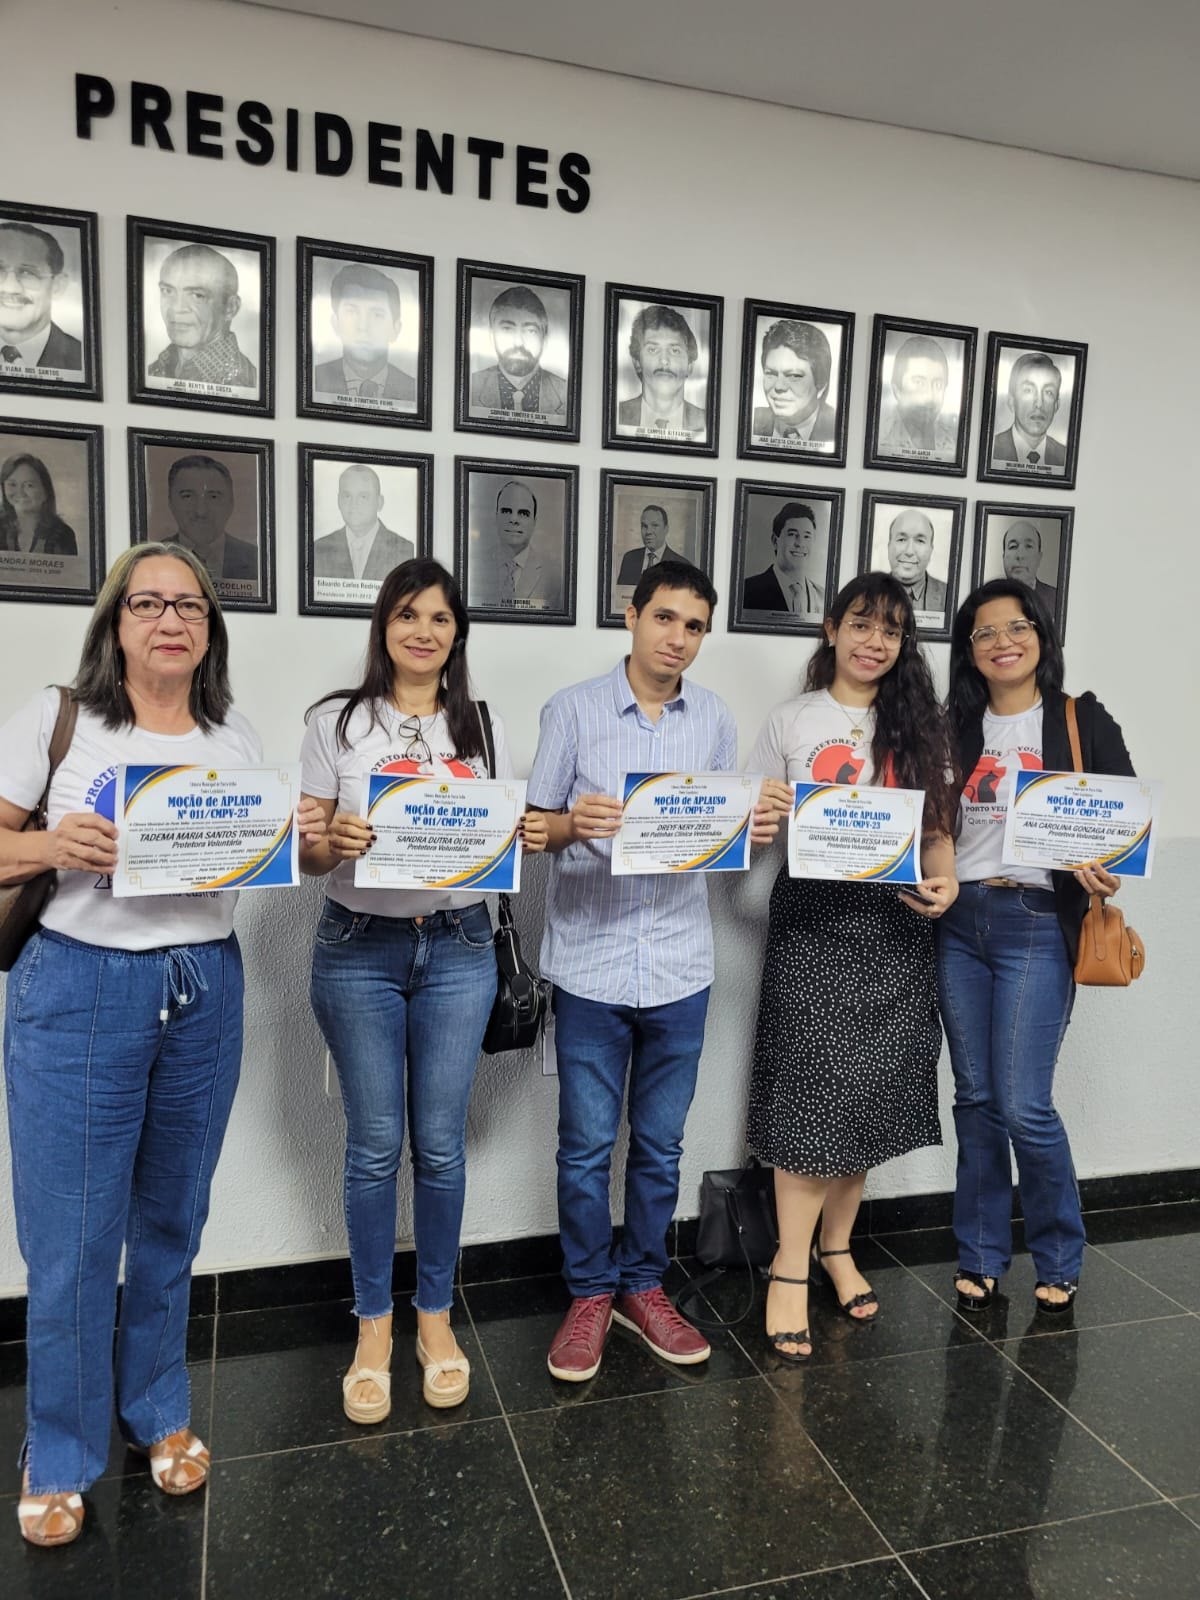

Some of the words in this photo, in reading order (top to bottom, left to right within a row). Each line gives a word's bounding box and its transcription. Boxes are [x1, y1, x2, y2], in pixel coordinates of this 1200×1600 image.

[75, 73, 592, 214] PRESIDENTES
[0, 557, 26, 566] ANDRA
[28, 560, 65, 568] MORAES
[220, 582, 252, 590] COELHO
[805, 738, 858, 768] PROTETORES
[371, 752, 422, 773] OTETORES
[85, 766, 118, 806] PROTE
[168, 794, 203, 808] MOÇÃO
[206, 796, 218, 807] de
[221, 794, 262, 807] APLAUSO
[654, 794, 679, 806] MOÇÃO
[682, 796, 692, 805] de
[694, 795, 726, 805] APLAUSO
[1046, 794, 1074, 807] MOÇÃO
[1076, 798, 1086, 806] de
[1088, 798, 1124, 811] APLAUSO
[189, 808, 249, 820] 011/CMPV-23
[404, 804, 434, 817] MOÇÃO
[438, 806, 448, 816] de
[450, 806, 488, 818] APLAUSO
[669, 806, 715, 815] 011/CMPV-23
[823, 807, 847, 819] MOÇÃO
[849, 809, 859, 819] de
[860, 811, 891, 821] APLAUSO
[1062, 807, 1112, 819] 011/CMPV-23
[423, 817, 476, 828] 011/CMPV-23
[838, 819, 881, 829] 011/CMPV-23
[1038, 822, 1072, 831] CAROLINA
[1073, 825, 1106, 834] GONZAGA
[1106, 827, 1115, 835] DE
[1116, 828, 1137, 837] MELO
[140, 832, 175, 842] TADEMA
[175, 831, 203, 841] MARIA
[205, 830, 238, 840] SANTOS
[239, 828, 278, 838] TRINDADE
[396, 835, 427, 844] SANDRA
[428, 836, 453, 845] DUTRA
[454, 837, 486, 846] OLIVEIRA
[808, 833, 839, 842] GIOVANNA
[839, 835, 861, 844] BRUNA
[861, 837, 881, 845] BESSA
[881, 838, 899, 847] MOTA
